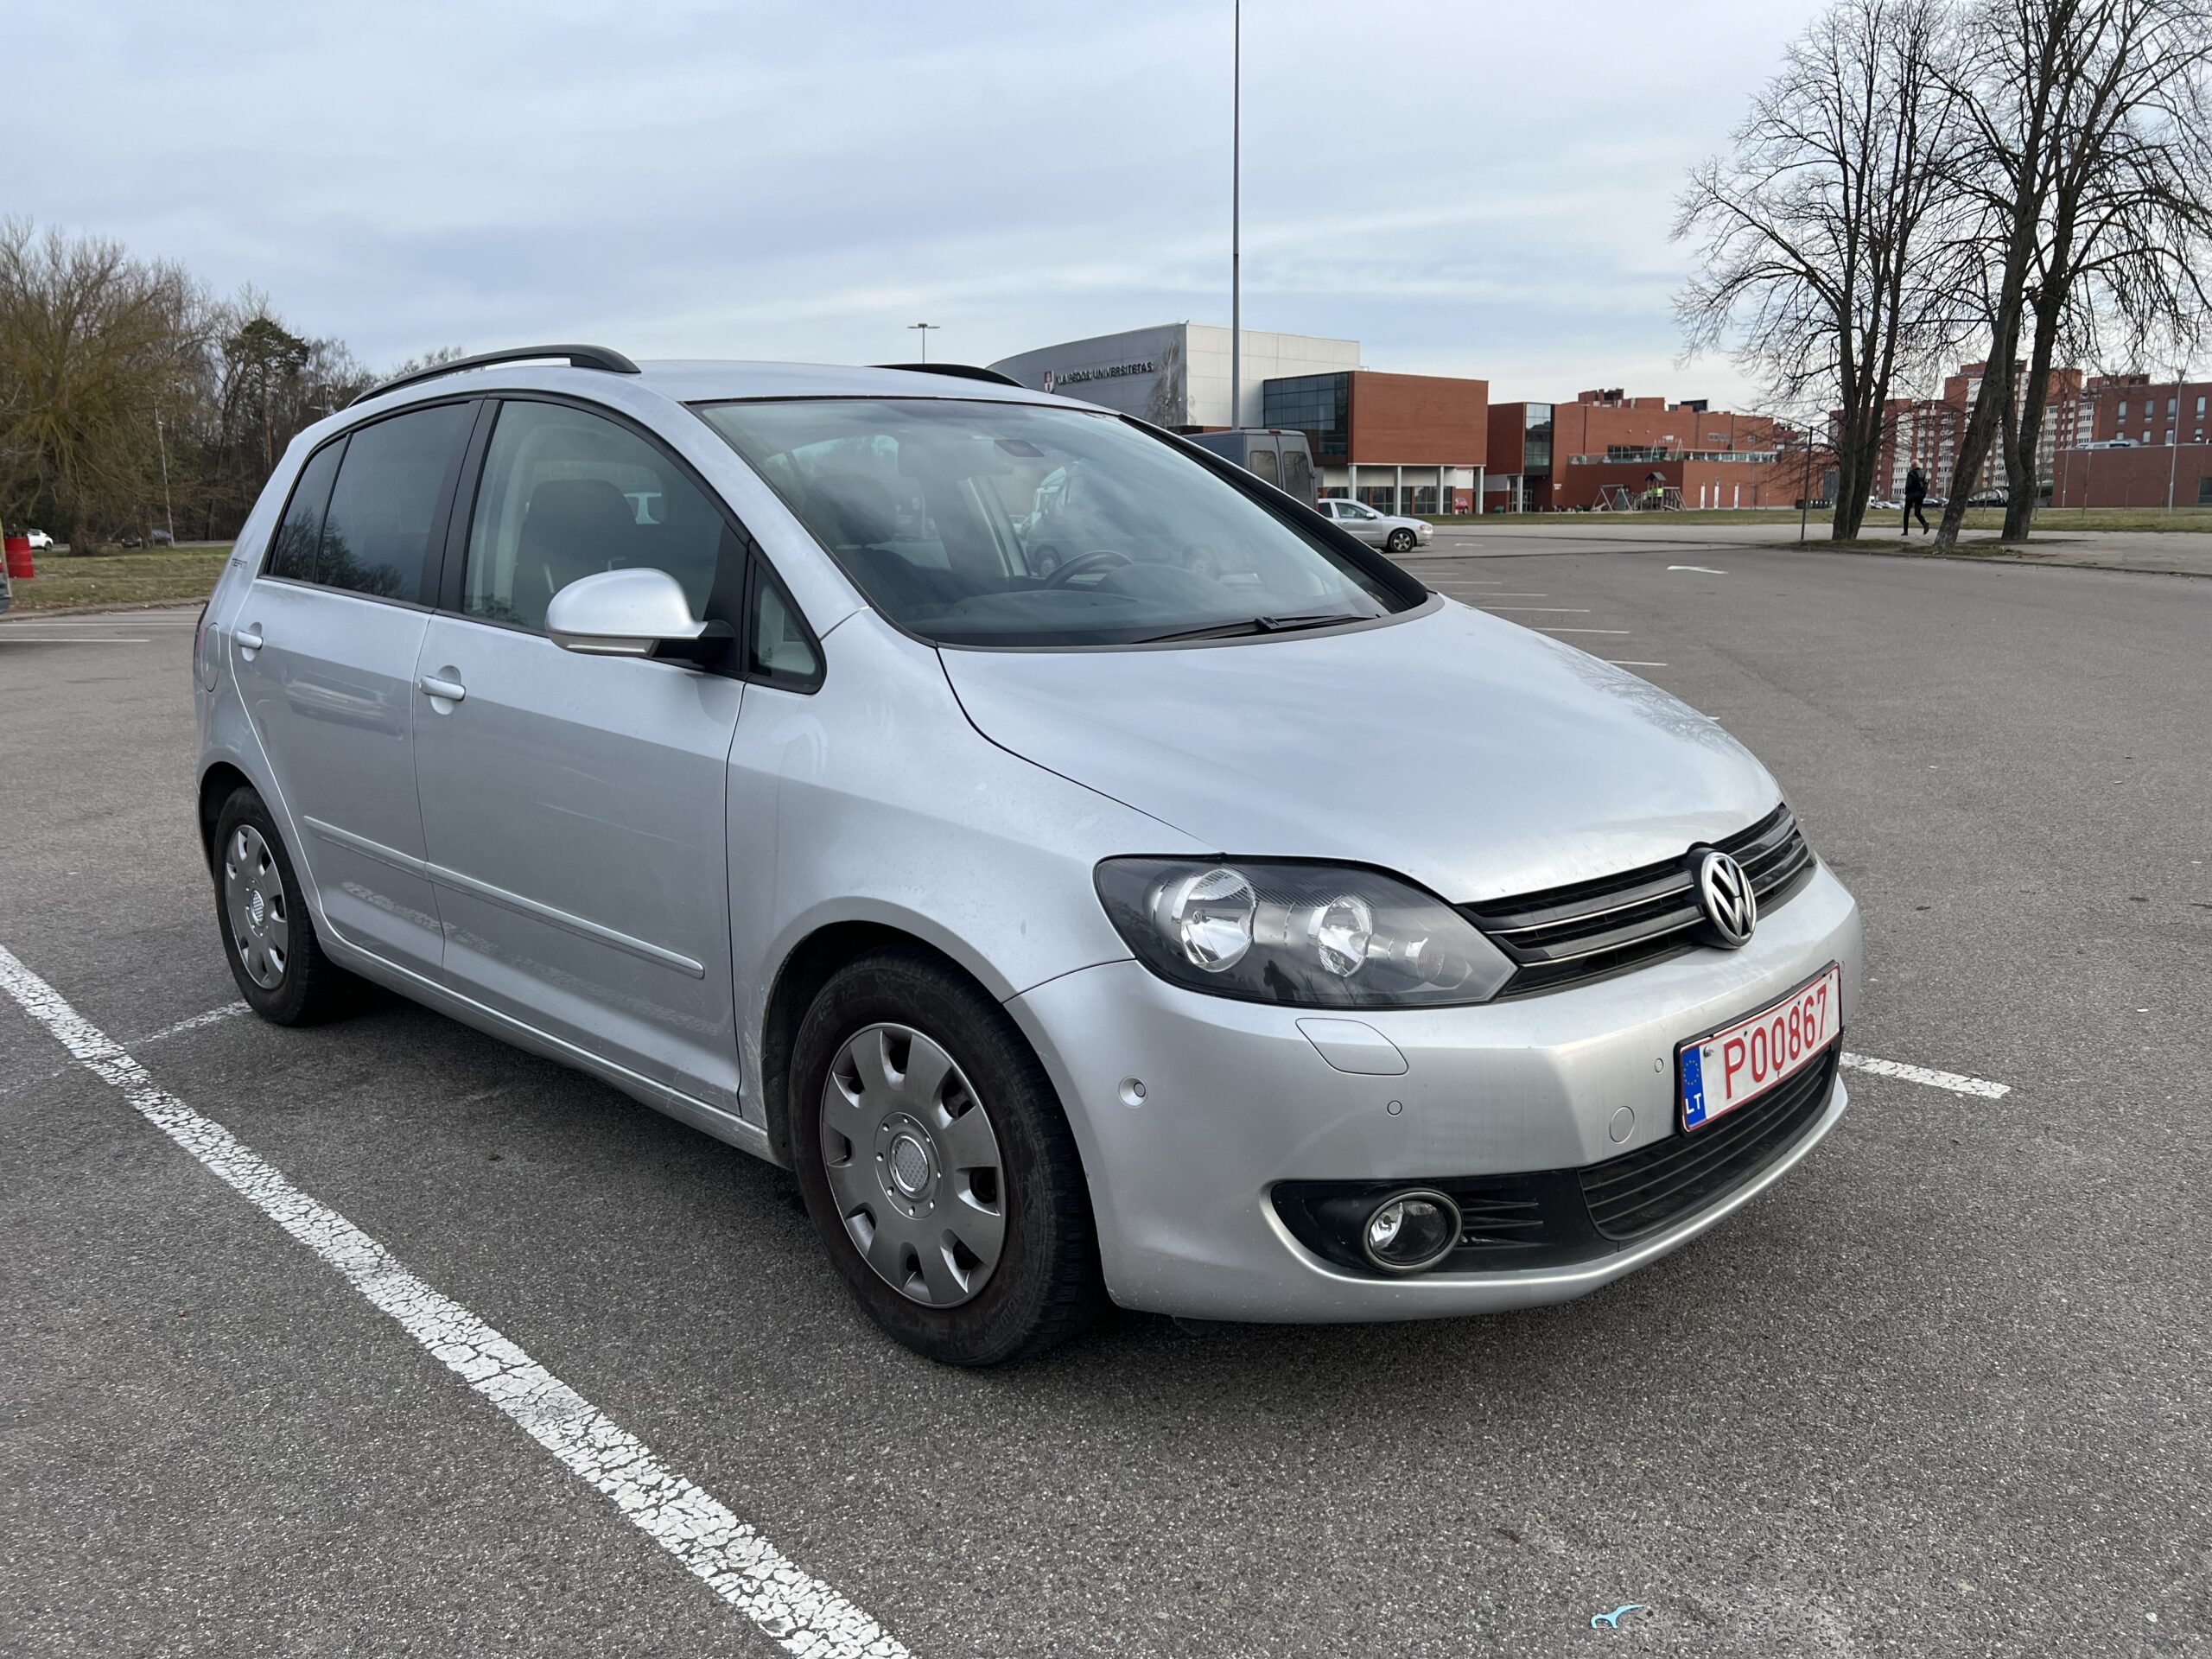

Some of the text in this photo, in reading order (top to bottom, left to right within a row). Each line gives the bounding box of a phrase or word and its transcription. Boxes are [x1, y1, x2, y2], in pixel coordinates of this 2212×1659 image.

[1093, 362, 1154, 379] UNIVERSITETAS
[1723, 983, 1827, 1099] P00867
[1685, 1093, 1701, 1115] LT
